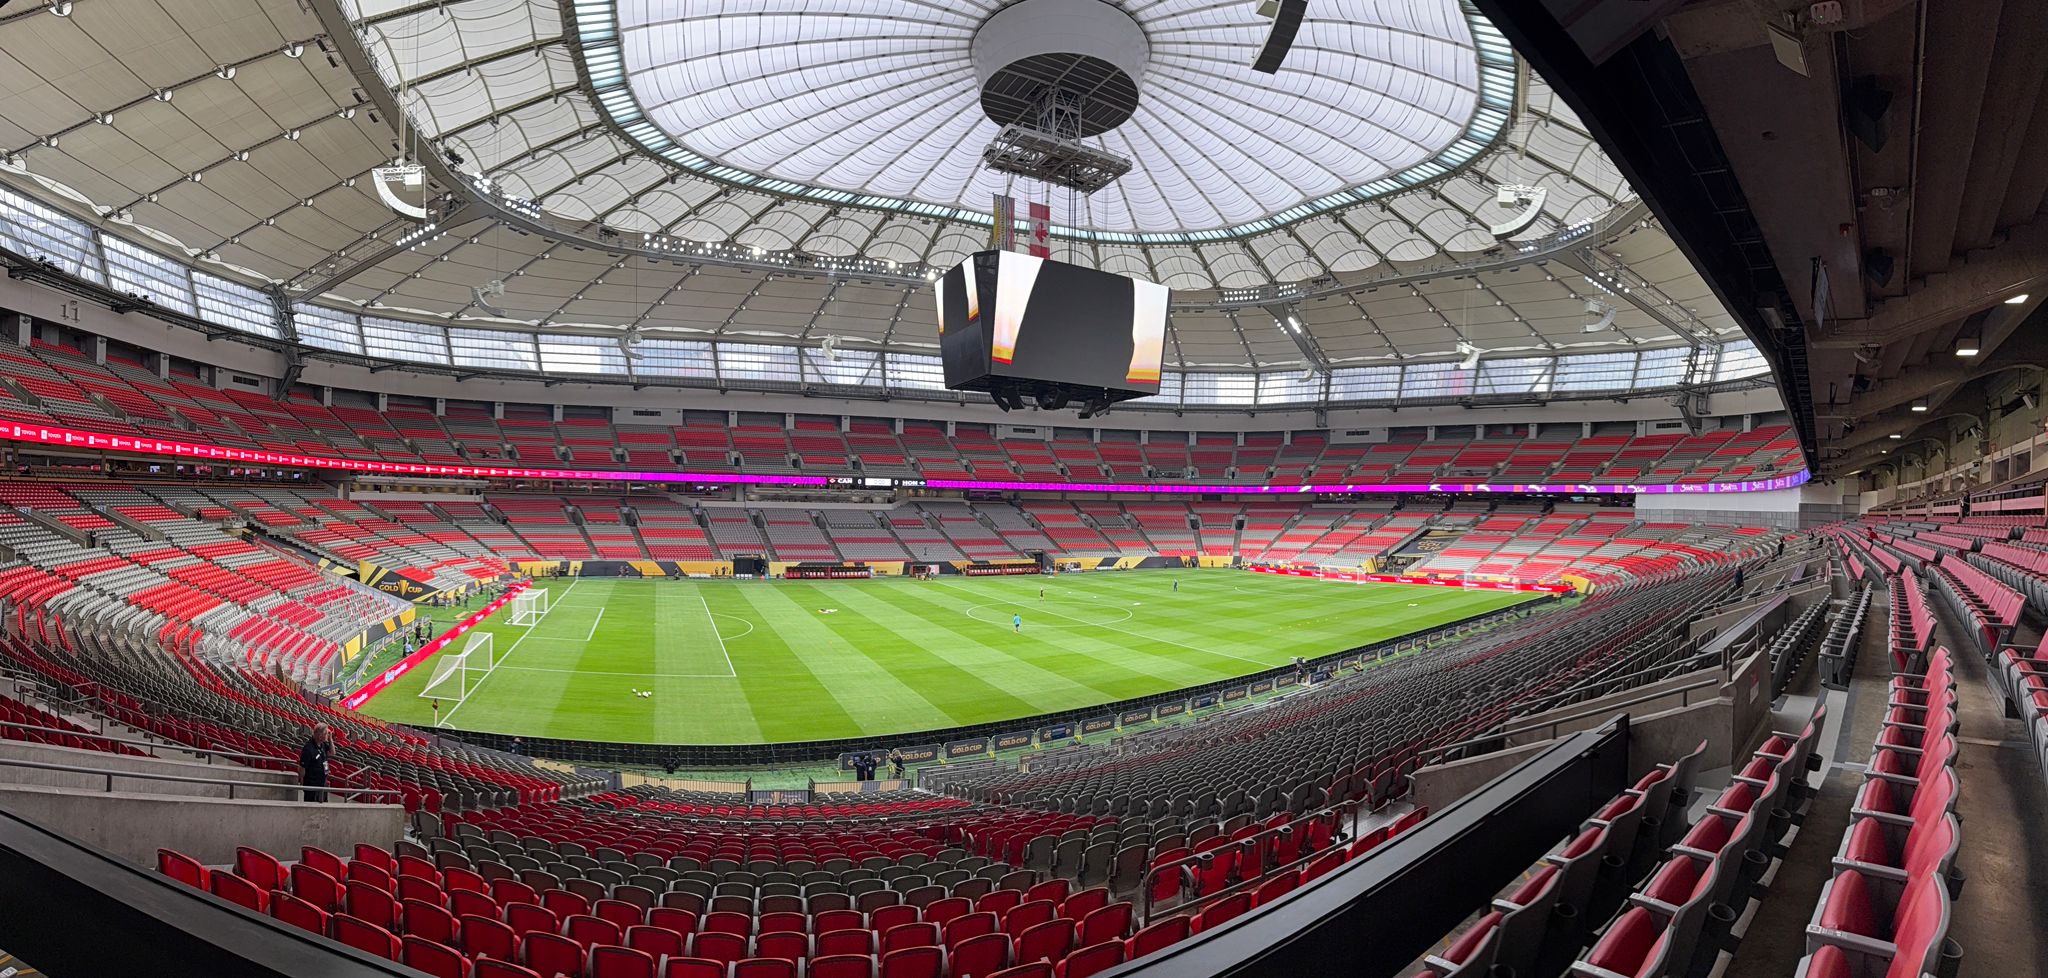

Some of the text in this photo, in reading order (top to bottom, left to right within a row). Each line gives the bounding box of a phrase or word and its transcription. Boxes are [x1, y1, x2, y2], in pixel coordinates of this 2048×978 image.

[1085, 723, 1101, 731] GOLD
[999, 739, 1016, 747] GOLD
[952, 745, 969, 754] GOLD
[902, 753, 919, 761] GOLD
[919, 751, 933, 759] CUP
